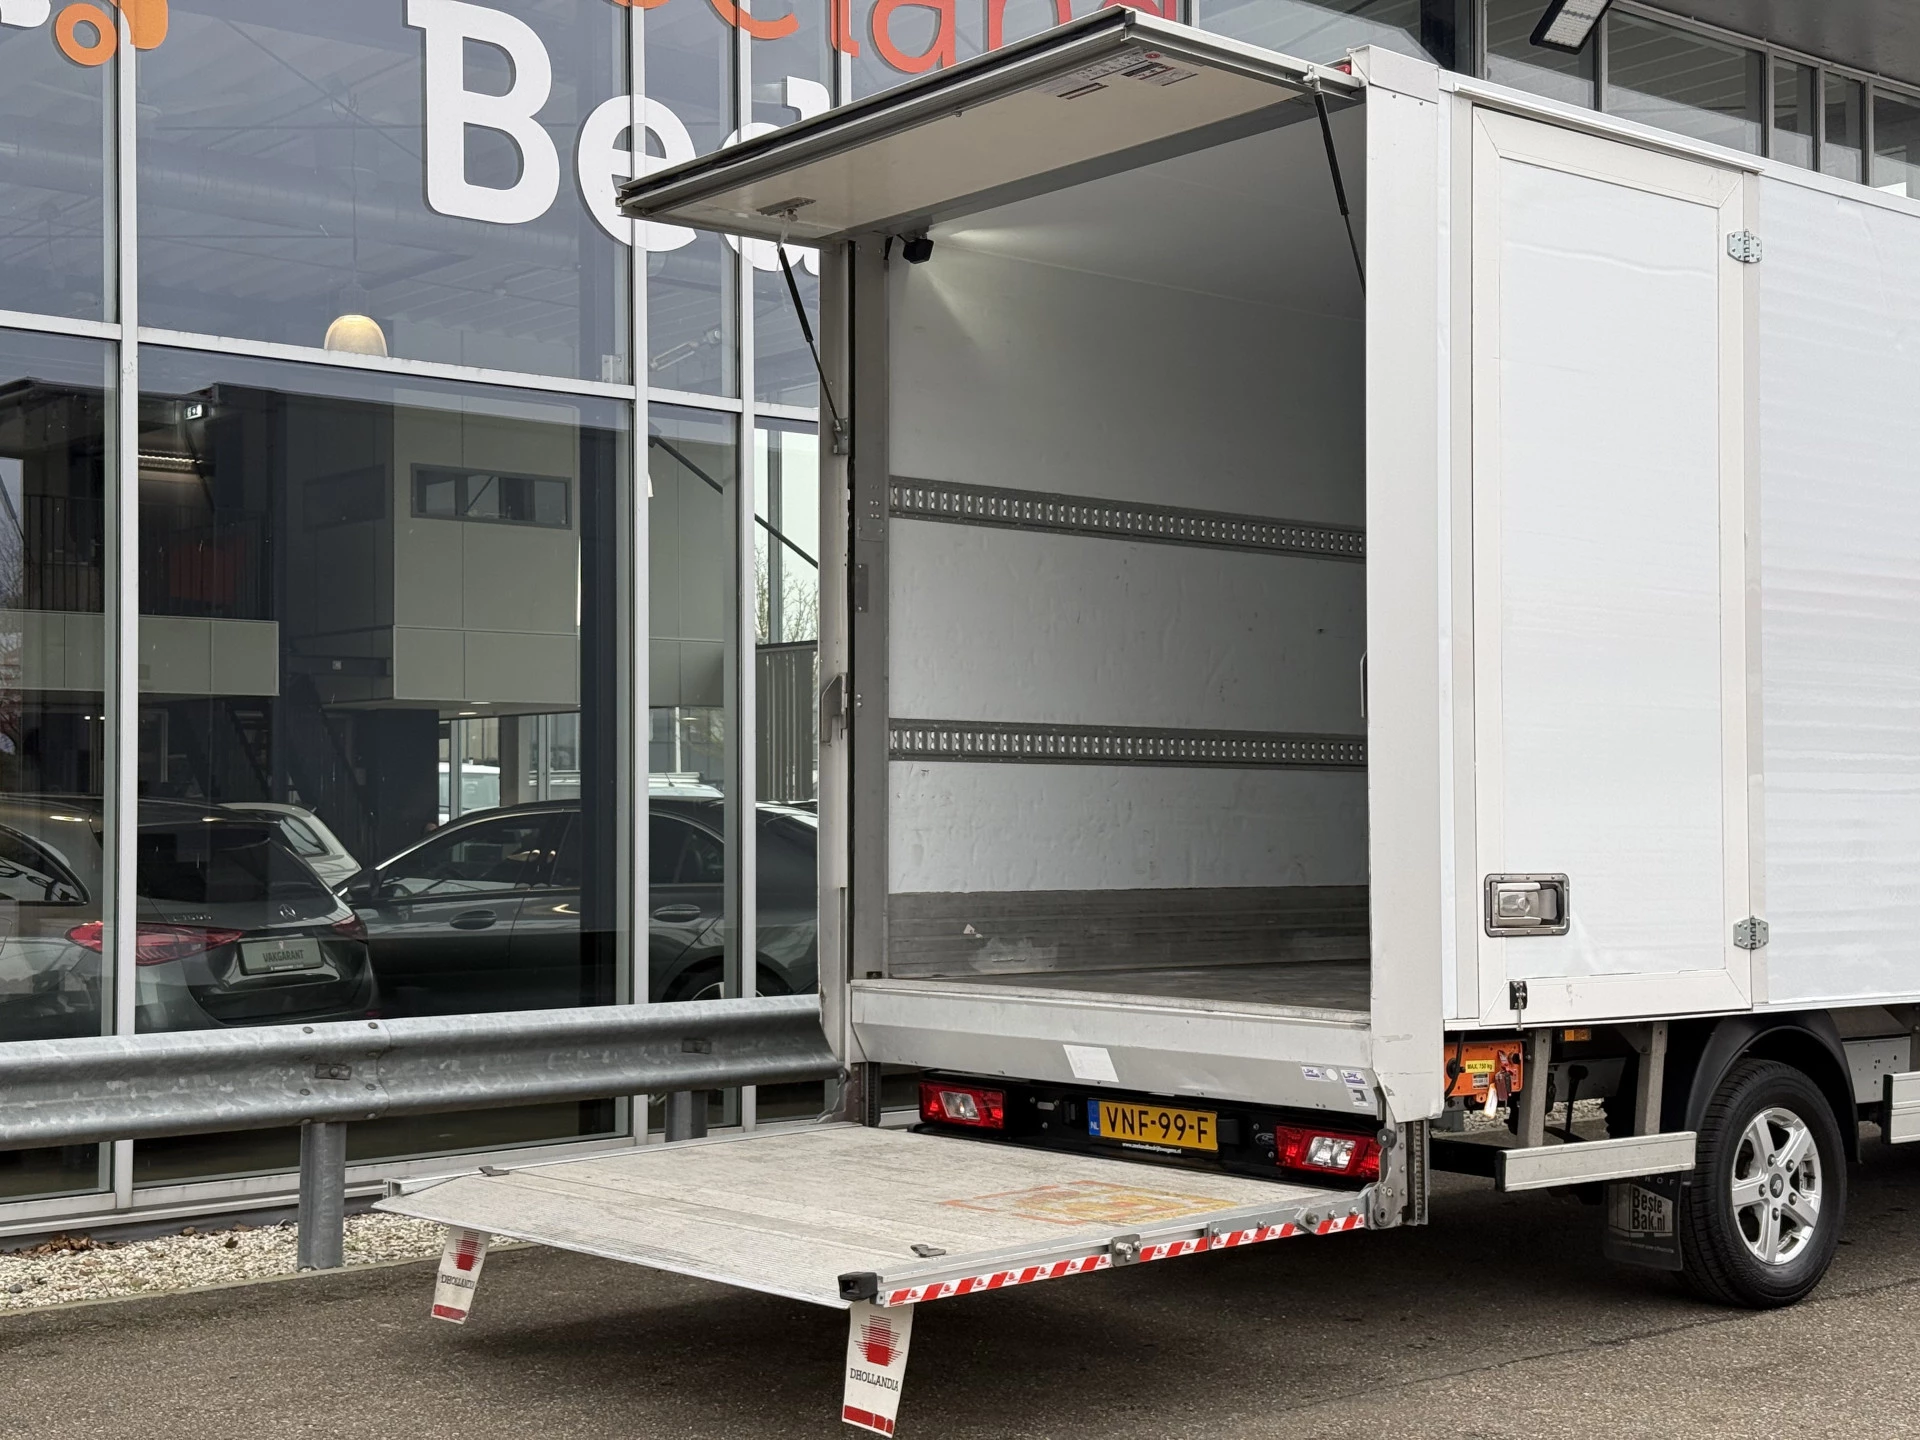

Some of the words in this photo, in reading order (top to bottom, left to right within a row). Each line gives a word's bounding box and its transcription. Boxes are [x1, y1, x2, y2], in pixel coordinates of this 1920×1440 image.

[261, 949, 304, 963] VAKGARANT
[1090, 1121, 1099, 1130] NL
[1106, 1106, 1209, 1144] VNF-99-F
[1643, 1175, 1675, 1186] HOF
[1632, 1187, 1663, 1214] Beste
[1631, 1208, 1666, 1231] Bak.nl
[849, 1367, 899, 1392] DHOLLANDIA
